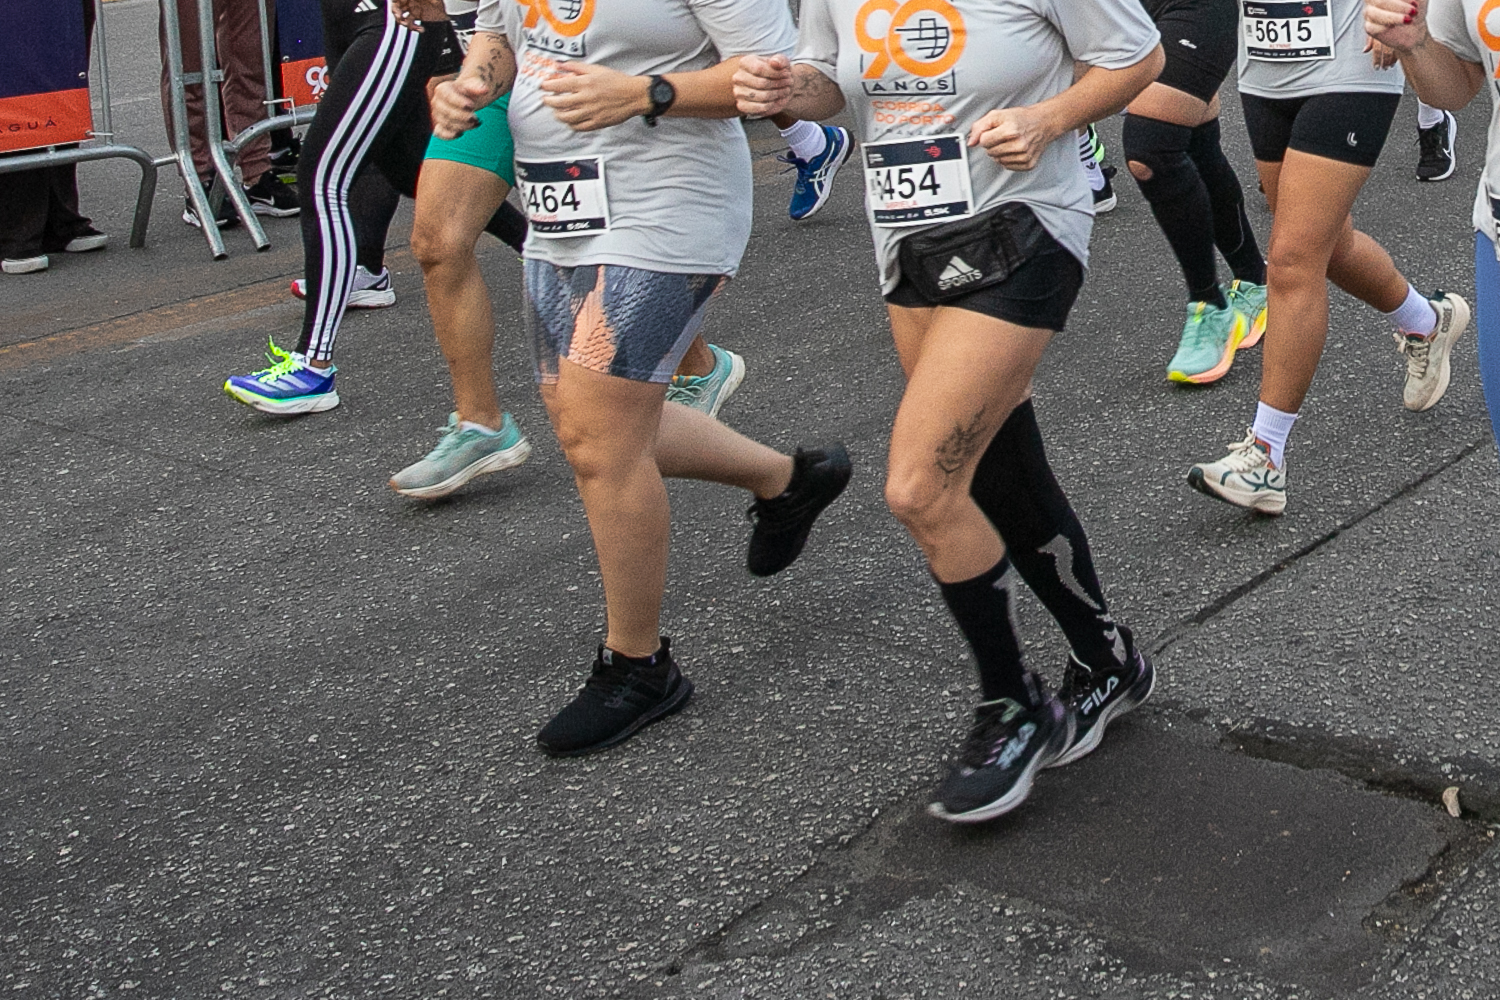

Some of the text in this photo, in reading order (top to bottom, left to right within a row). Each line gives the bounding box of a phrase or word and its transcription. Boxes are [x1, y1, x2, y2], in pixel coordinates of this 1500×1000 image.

[1255, 19, 1312, 44] 5615
[527, 34, 579, 52] ANOS
[872, 79, 950, 92] ANOS
[872, 100, 946, 112] CORRIDA
[874, 112, 957, 126] DO PORTO
[937, 268, 983, 291] SPORTS
[1080, 675, 1120, 716] FILA
